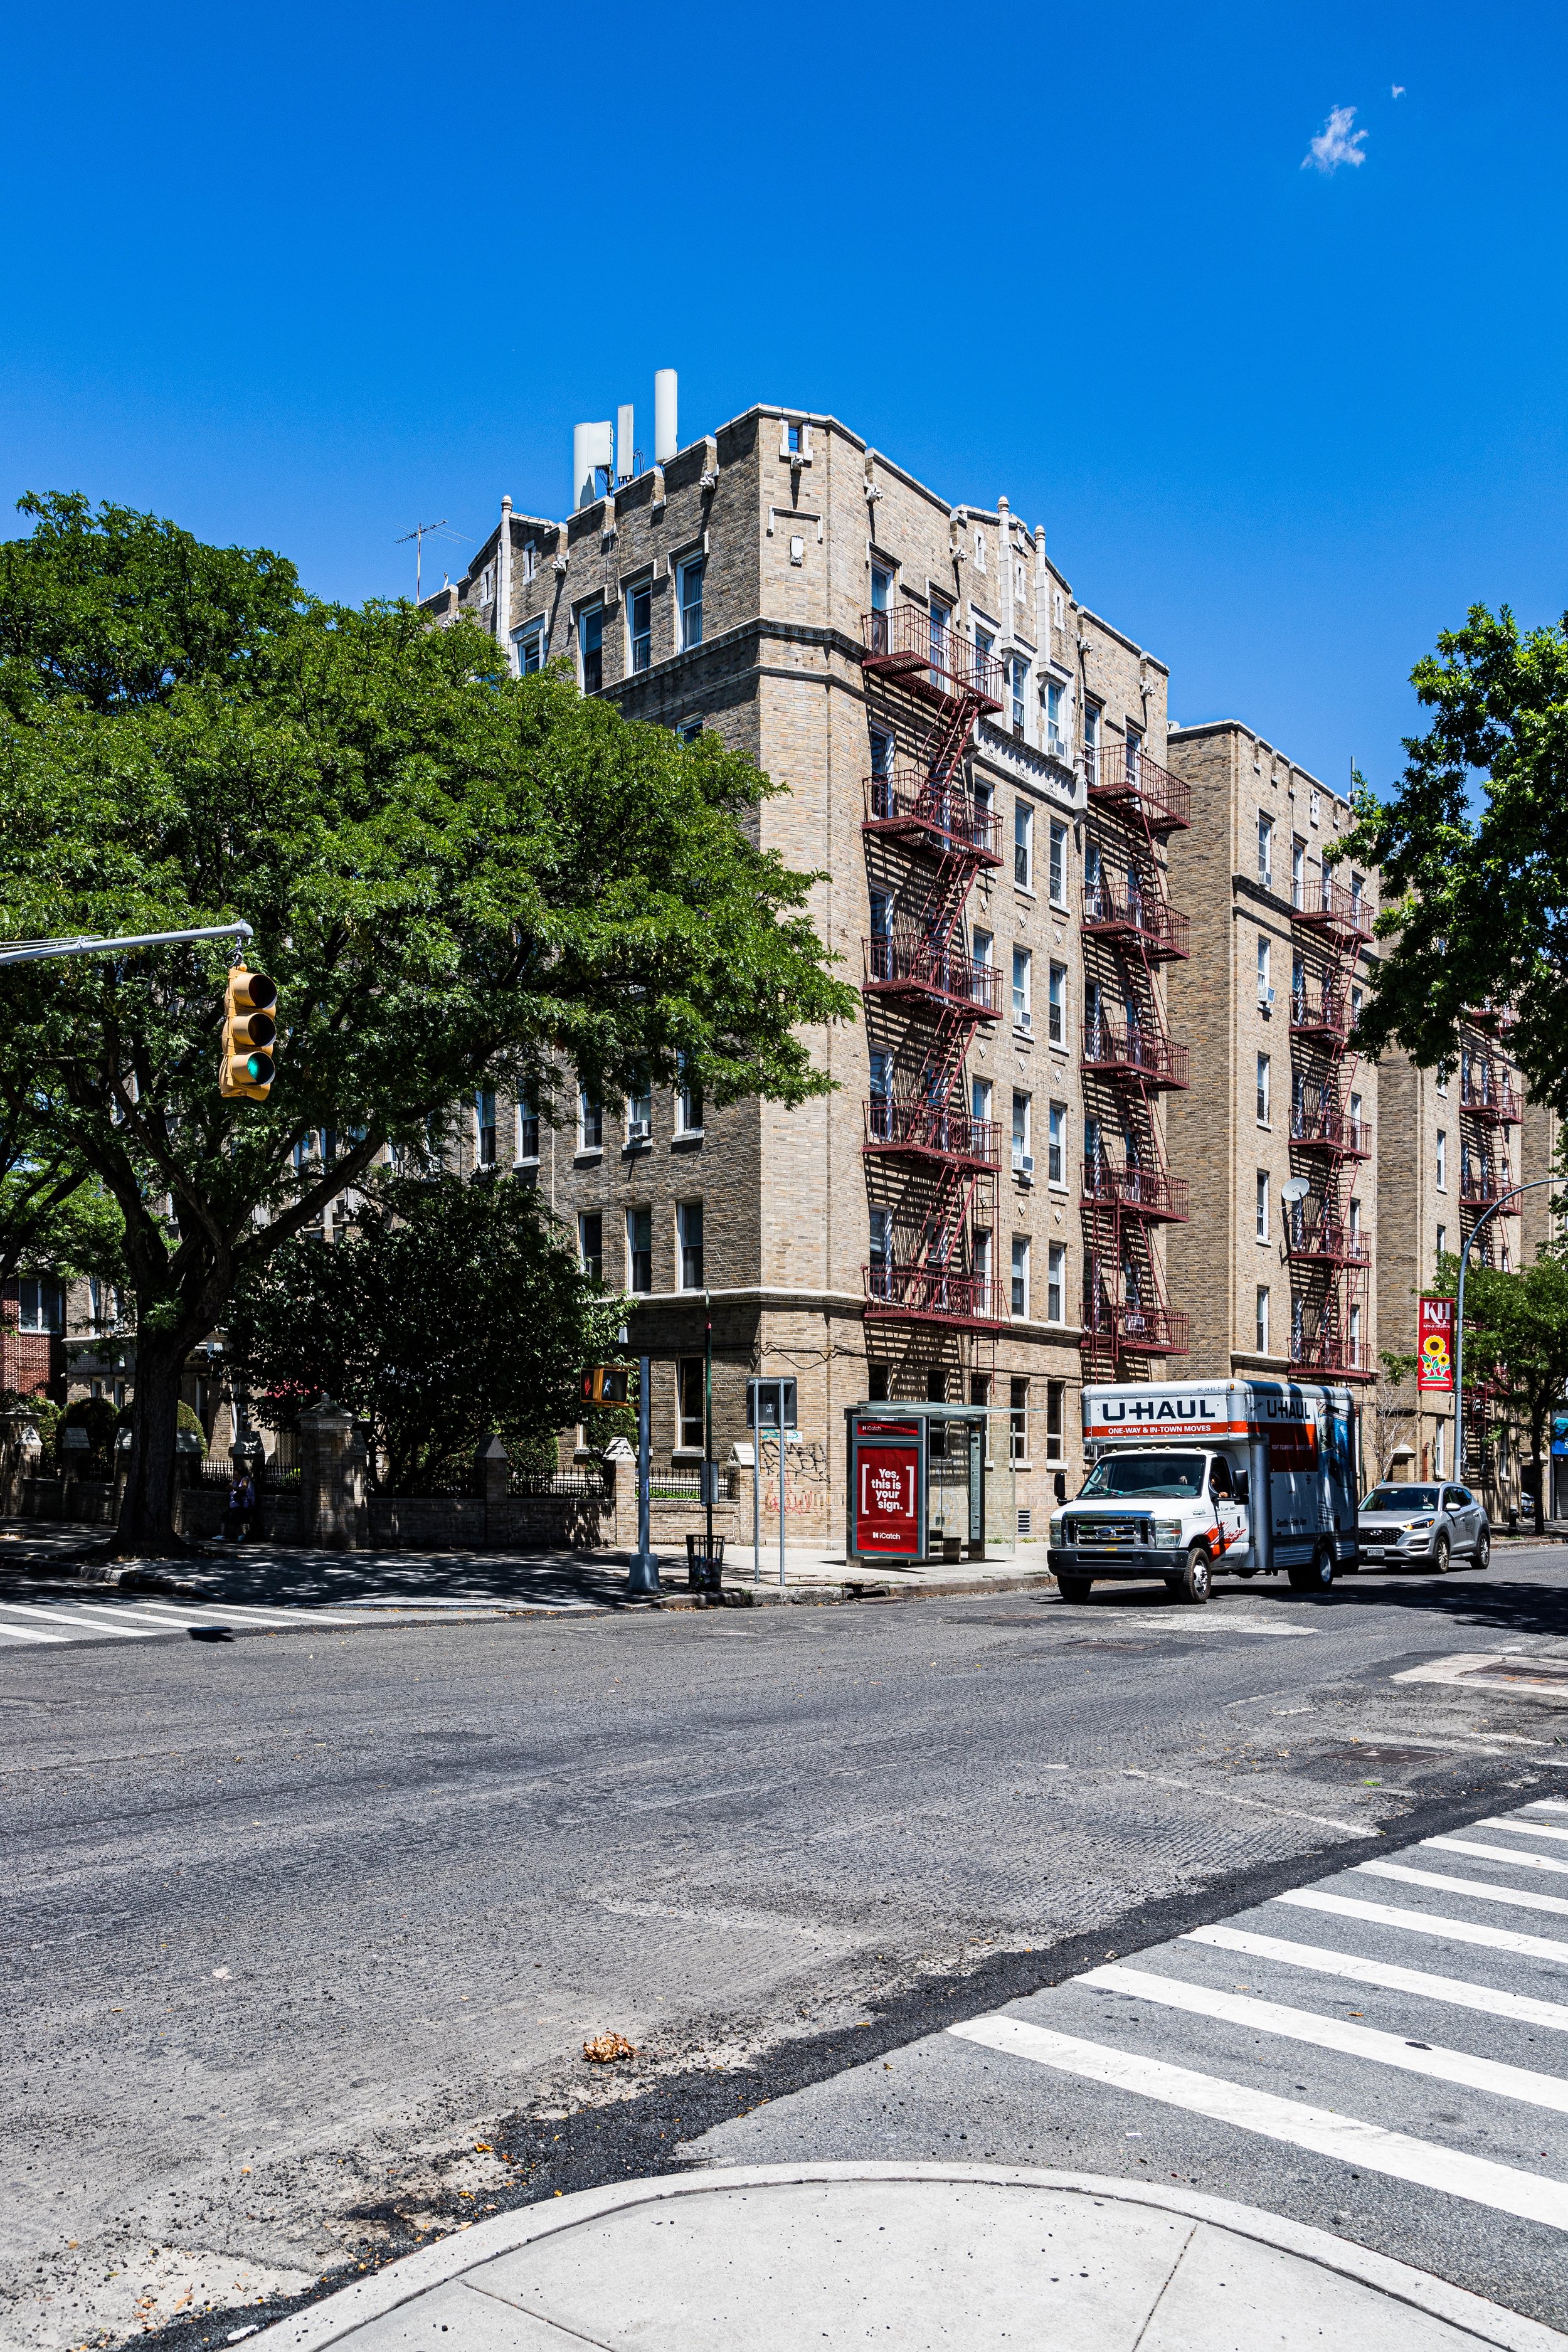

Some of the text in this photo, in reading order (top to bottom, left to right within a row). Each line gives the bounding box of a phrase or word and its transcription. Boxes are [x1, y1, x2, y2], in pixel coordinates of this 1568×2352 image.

[1423, 1302, 1450, 1325] KH
[1103, 1400, 1215, 1421] U-HAUL
[1267, 1400, 1310, 1419] U-HAUL
[879, 1468, 899, 1480] Yes,
[871, 1478, 901, 1490] this is
[876, 1490, 899, 1501] your
[878, 1498, 903, 1512] sign.
